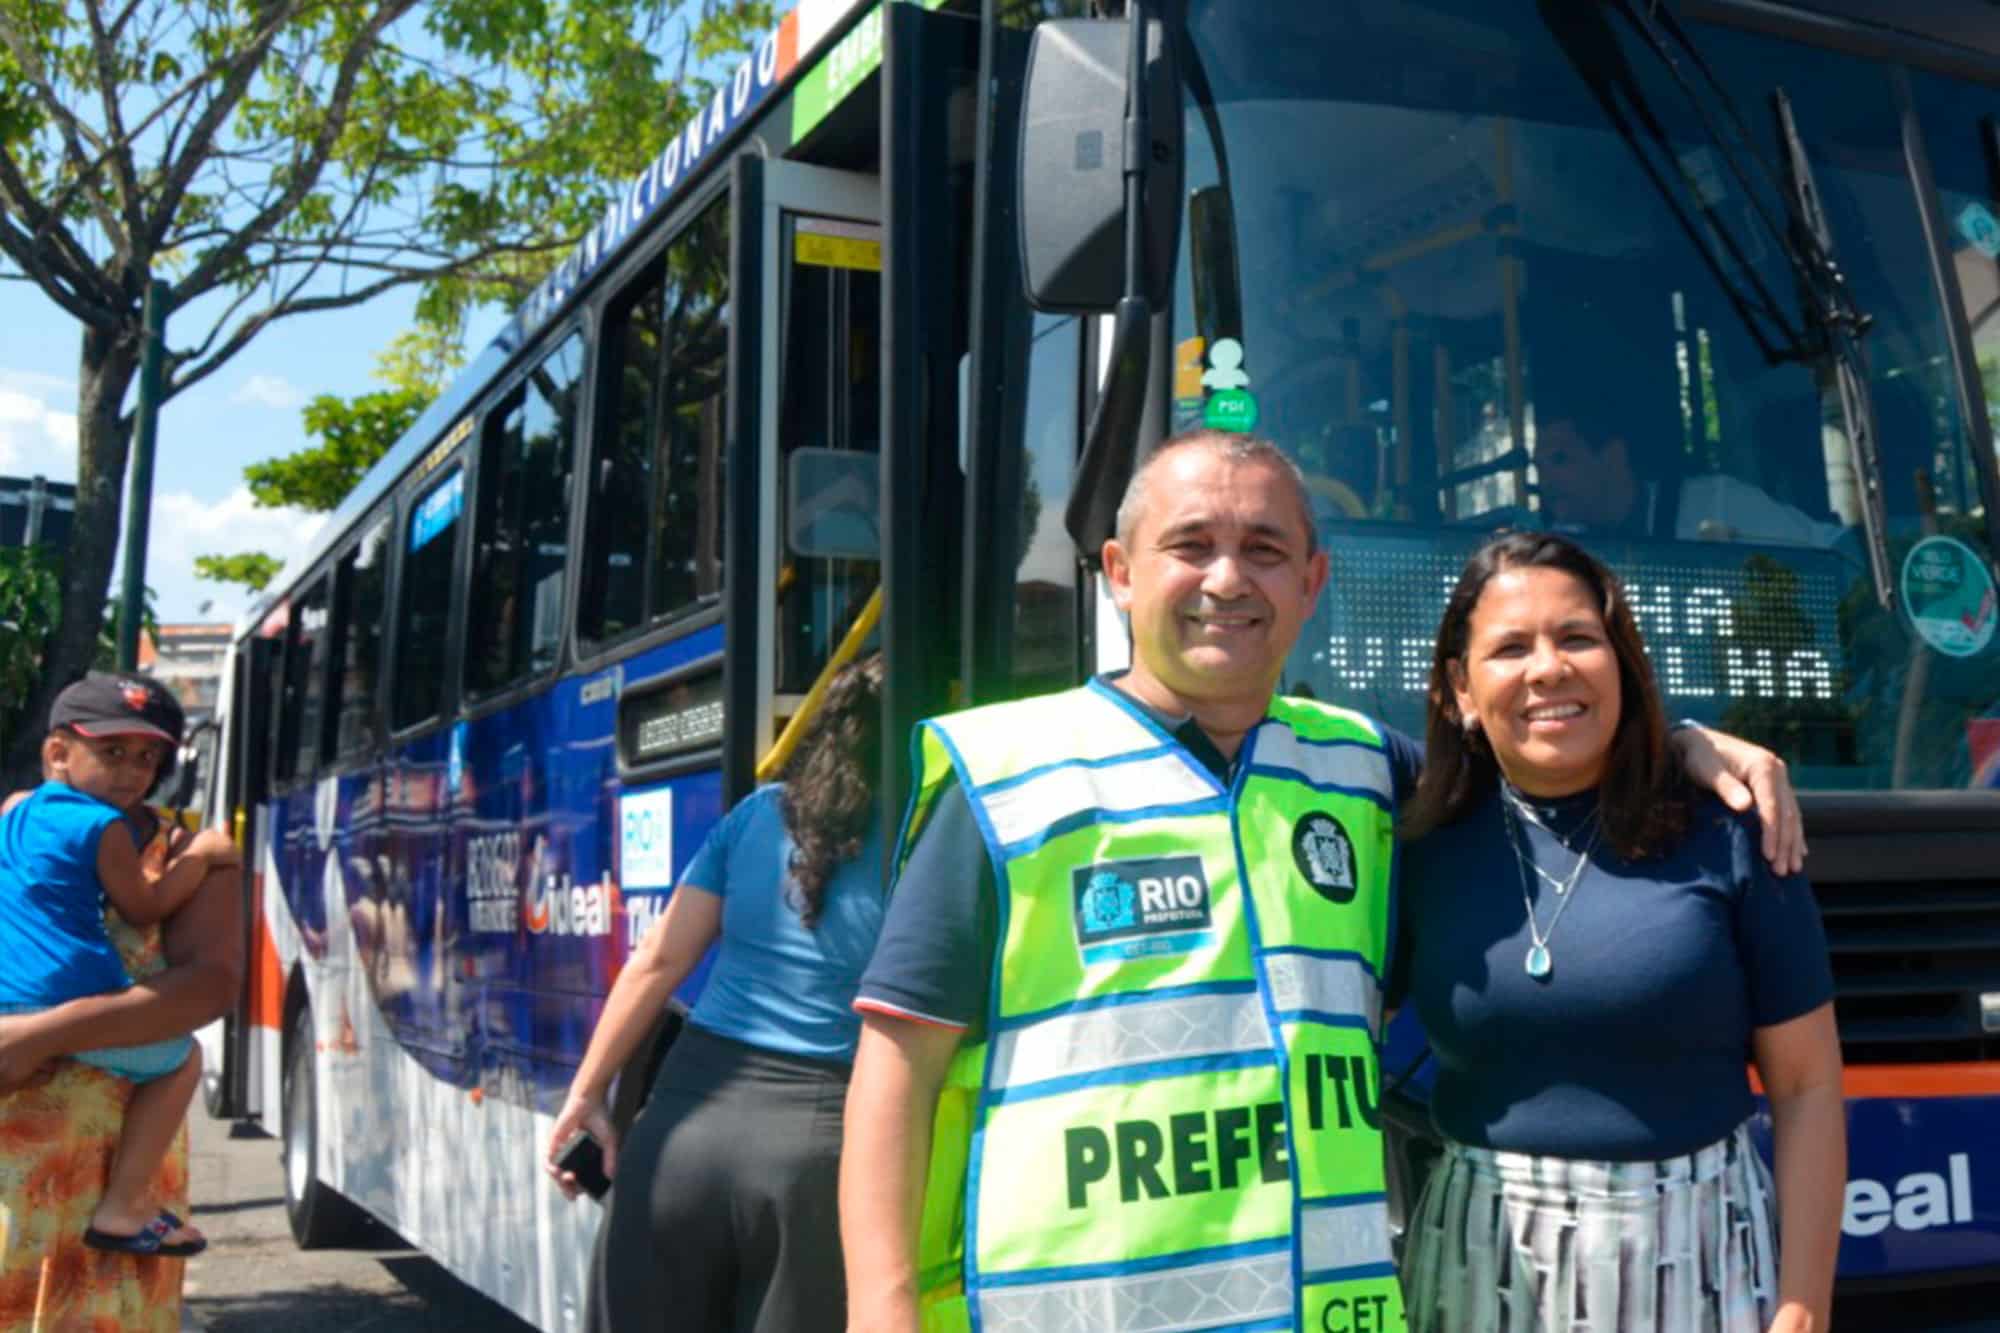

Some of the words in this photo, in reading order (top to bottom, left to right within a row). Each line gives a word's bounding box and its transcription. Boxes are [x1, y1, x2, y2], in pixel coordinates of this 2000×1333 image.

[547, 869, 612, 936] ideal
[1138, 875, 1203, 912] RIO
[1321, 1293, 1388, 1333] CET
